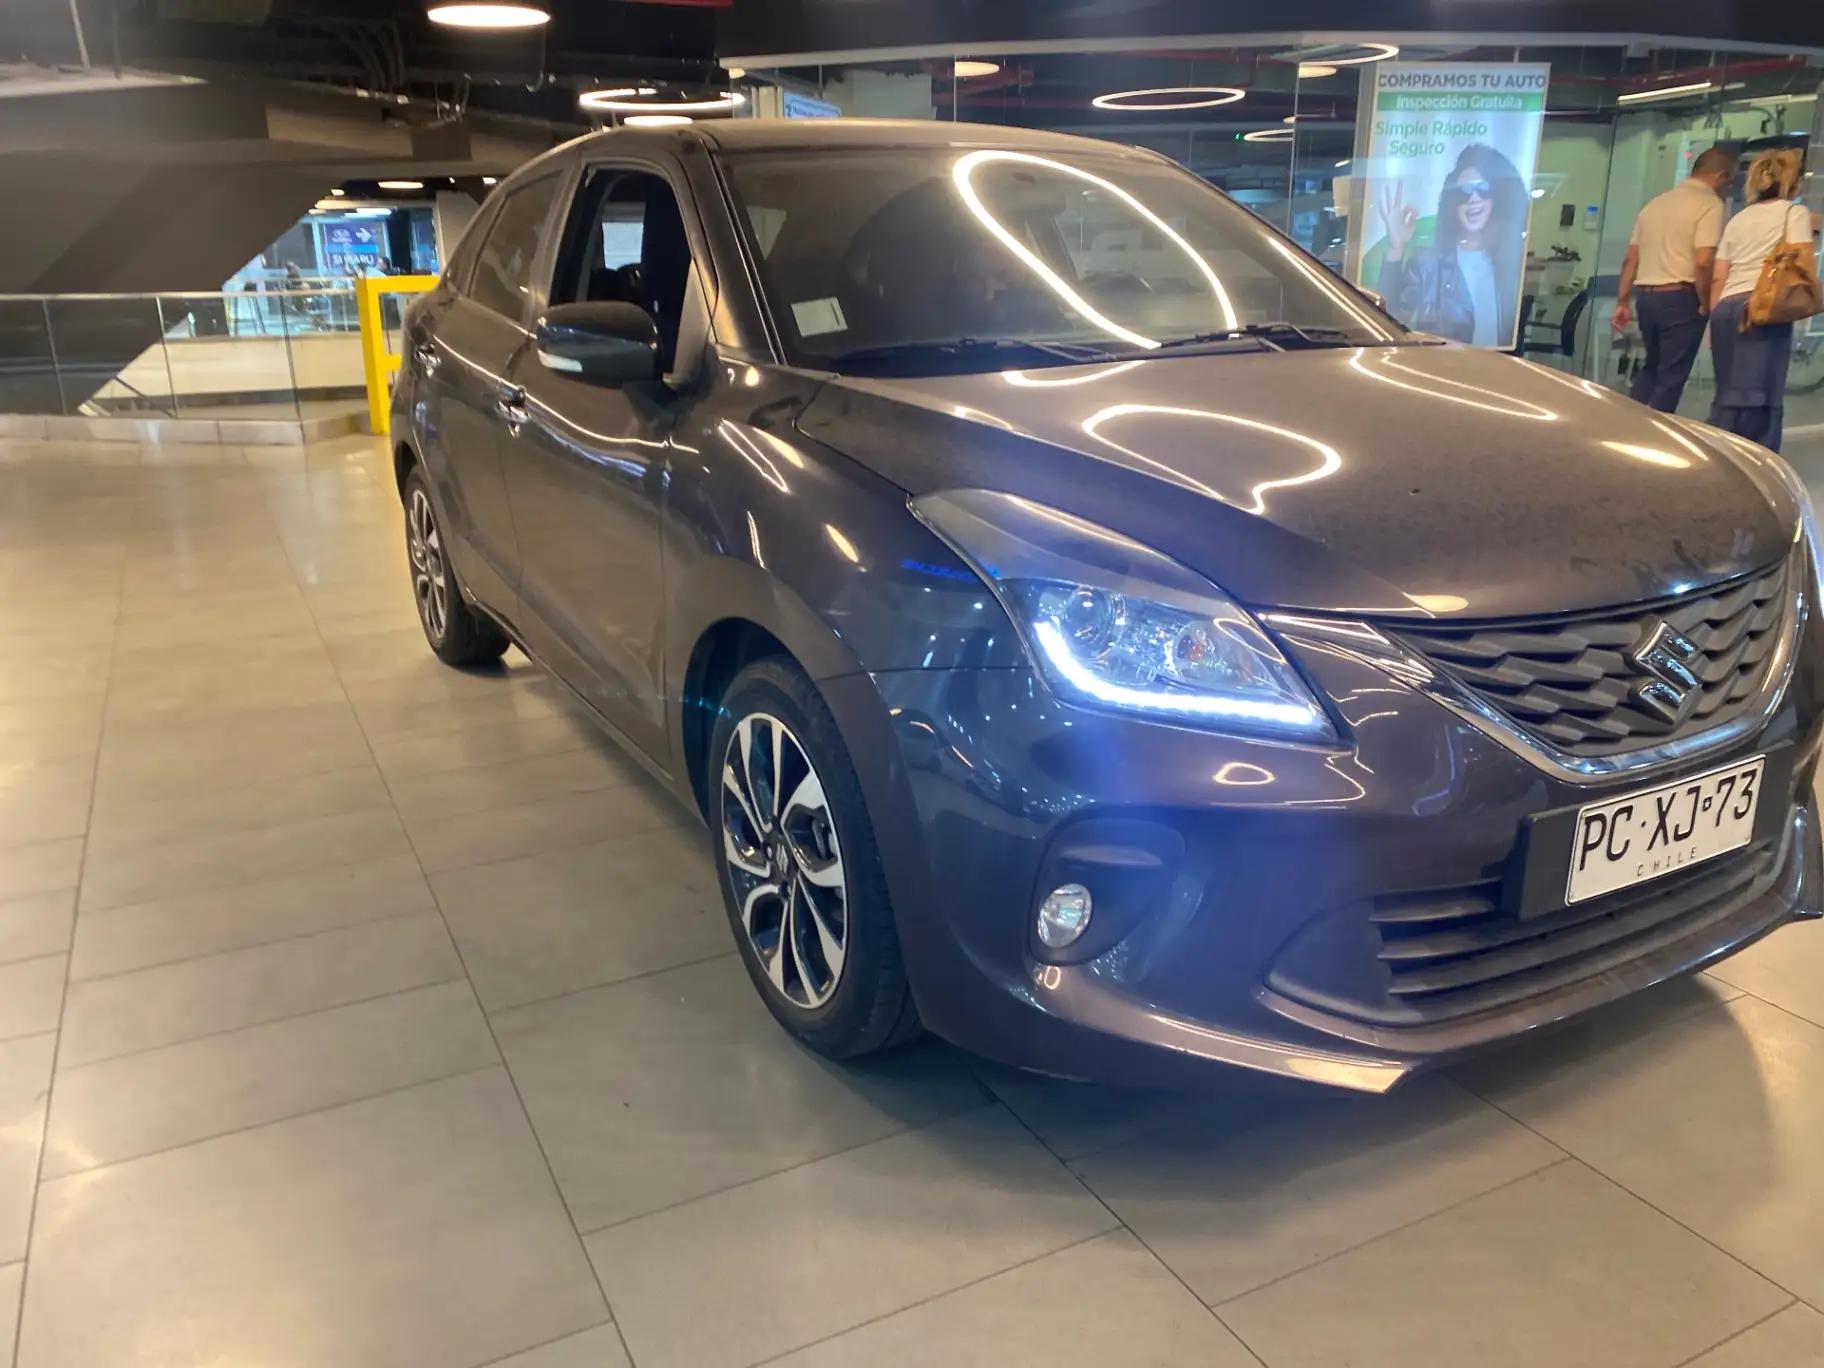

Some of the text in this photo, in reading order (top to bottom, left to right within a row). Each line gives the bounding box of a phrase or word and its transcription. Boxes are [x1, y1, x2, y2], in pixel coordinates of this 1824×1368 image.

[1378, 73, 1546, 88] COMPRAMOS TU AUTO
[1396, 94, 1523, 111] Inspección Gratuita
[1375, 120, 1428, 138] Simple
[1389, 140, 1445, 157] Seguro
[1636, 847, 1697, 877] CHILE
